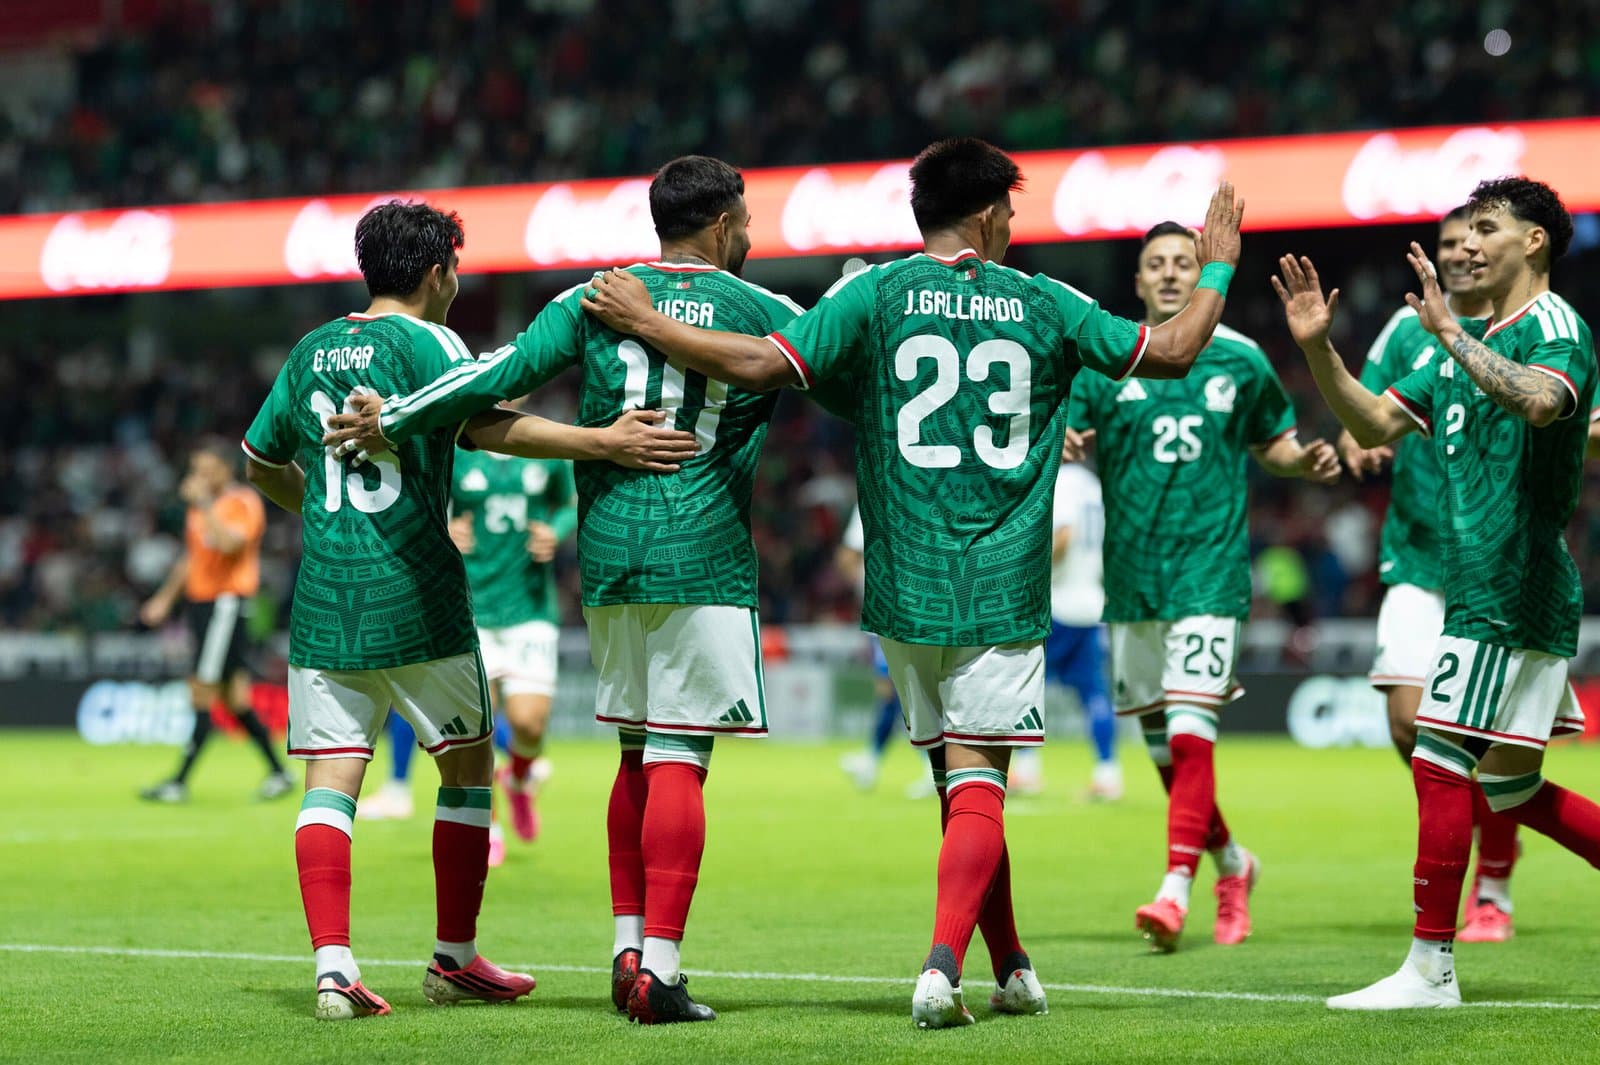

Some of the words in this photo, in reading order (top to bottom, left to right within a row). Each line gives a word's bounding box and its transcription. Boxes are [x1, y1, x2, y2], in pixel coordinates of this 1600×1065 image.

[904, 289, 1025, 322] J.GALLARDO
[895, 334, 1031, 469] 23
[1152, 414, 1204, 463] 25
[1183, 633, 1225, 678] 25
[1430, 652, 1460, 703] 2
